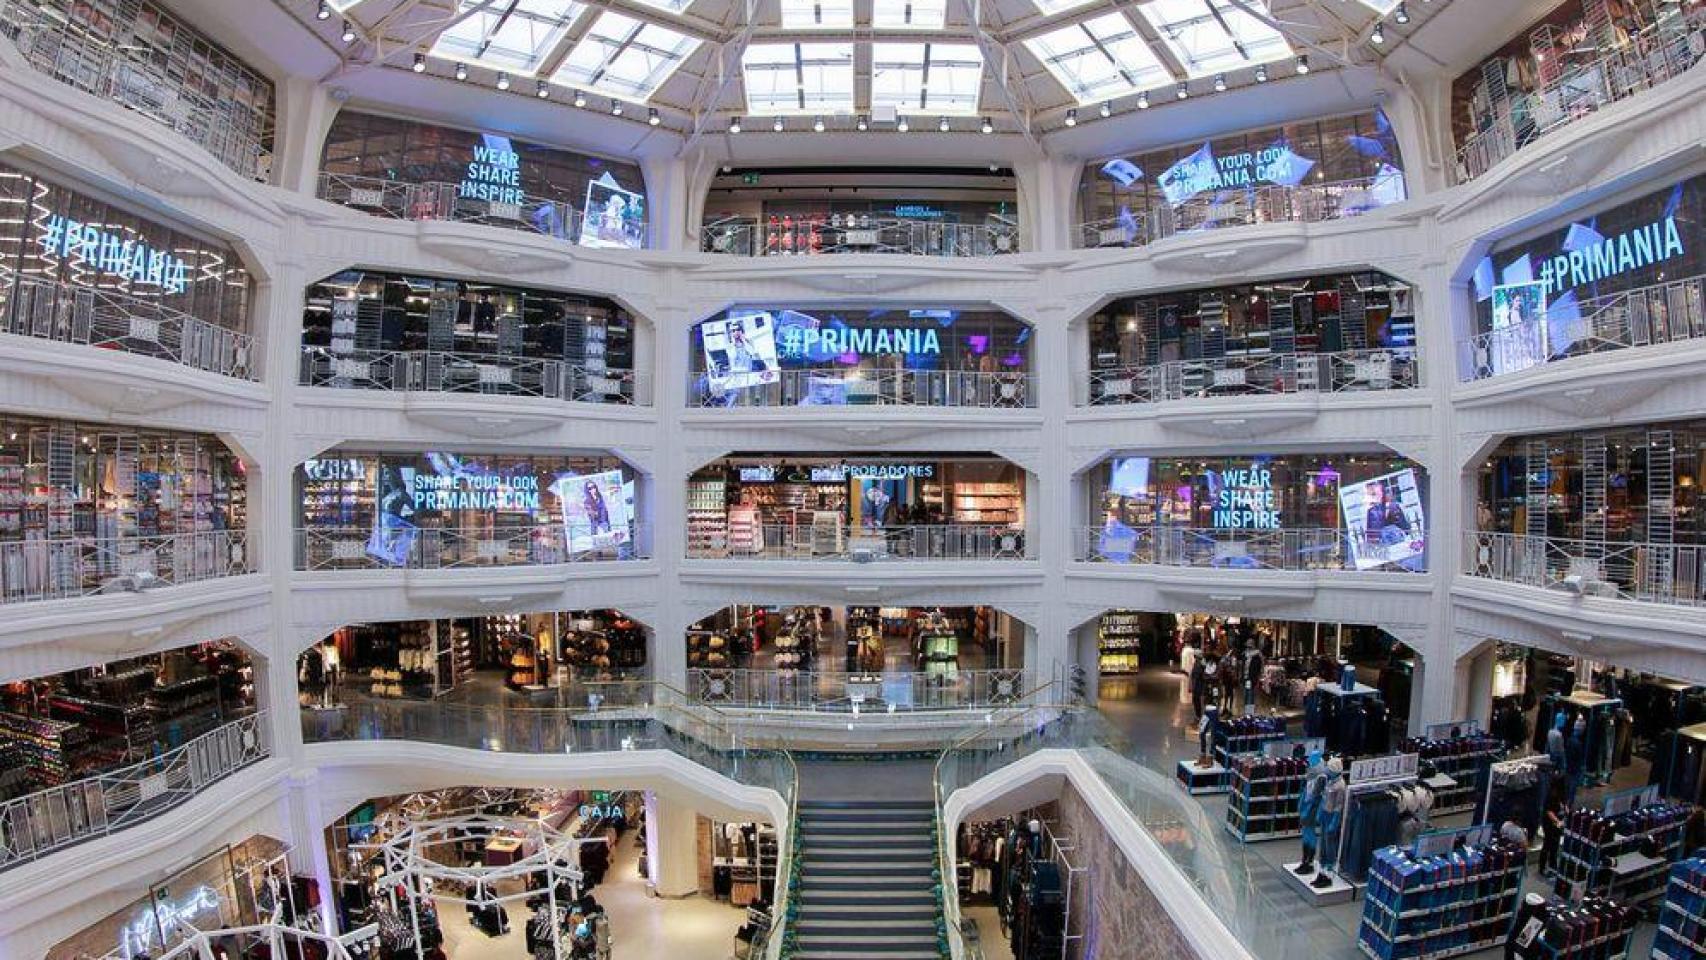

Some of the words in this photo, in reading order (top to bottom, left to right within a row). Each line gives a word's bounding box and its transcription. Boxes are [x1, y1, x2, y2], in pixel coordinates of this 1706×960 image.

[473, 144, 520, 169] WEAR
[1217, 153, 1253, 171] YOUR
[468, 162, 520, 186] SHARE
[1175, 160, 1294, 194] PRANIA.COM
[460, 180, 525, 206] INSPIRE
[44, 213, 185, 293] #PRIMANIA
[1540, 215, 1685, 294] #PRIMANIA
[784, 328, 941, 354] #PRIMANIA
[415, 474, 460, 490] SHARE
[466, 475, 501, 490] YOUR
[506, 475, 539, 490] LOOK
[842, 465, 933, 477] PROBADORES
[1222, 469, 1271, 488] WEAR
[1220, 489, 1274, 509] SHARE
[1214, 510, 1281, 528] INSPIRE
[580, 805, 623, 818] CAJA
